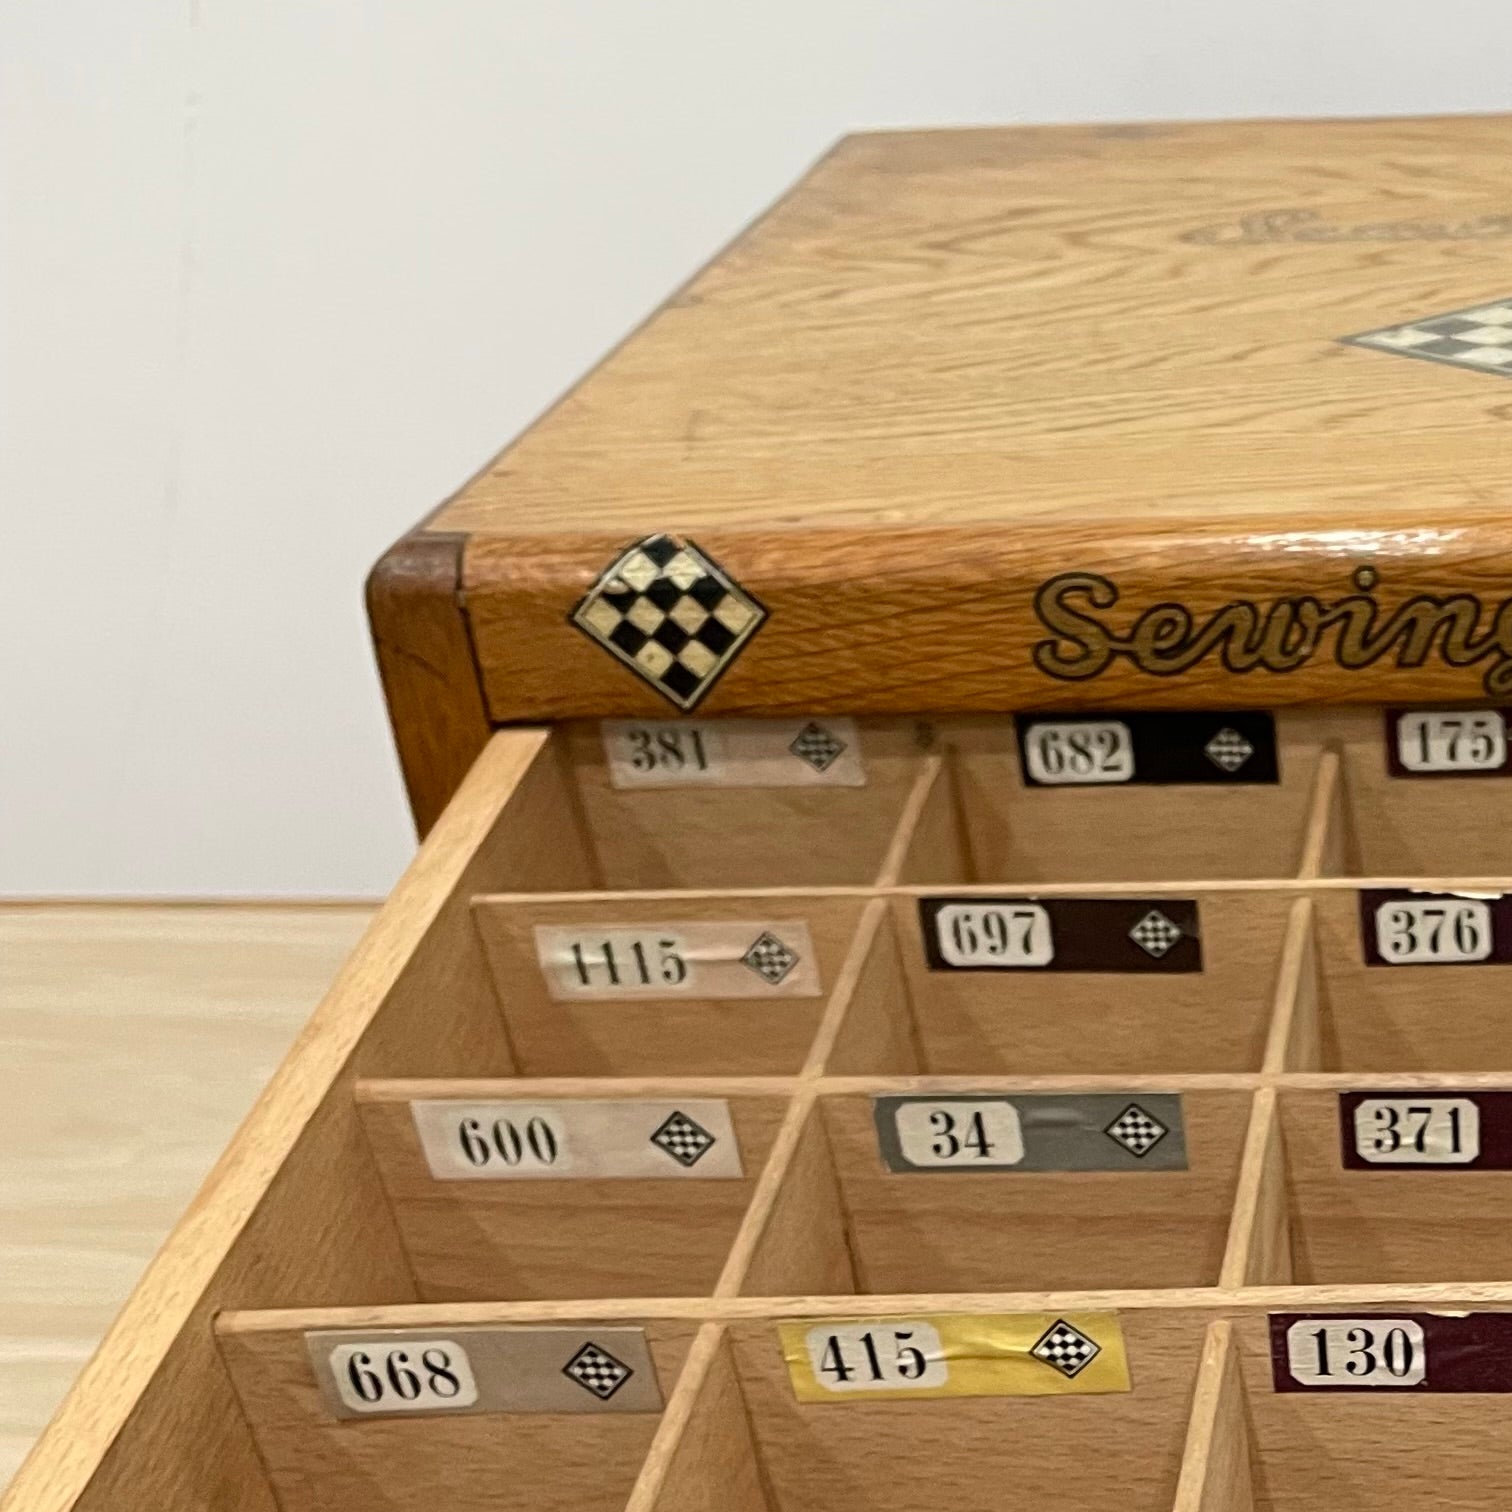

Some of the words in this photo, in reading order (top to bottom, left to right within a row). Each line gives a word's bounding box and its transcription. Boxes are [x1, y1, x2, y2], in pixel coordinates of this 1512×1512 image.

[626, 728, 709, 772] 381
[1038, 727, 1122, 774] 682
[1413, 719, 1497, 764] 175
[952, 910, 1036, 955] 697
[1389, 908, 1480, 955] 376
[571, 940, 687, 986] 1115
[458, 1118, 558, 1165] 600
[928, 1110, 995, 1158] 34
[1372, 1106, 1463, 1154] 371
[346, 1348, 461, 1402] 668
[821, 1331, 927, 1382] 415
[1311, 1327, 1414, 1378] 130
